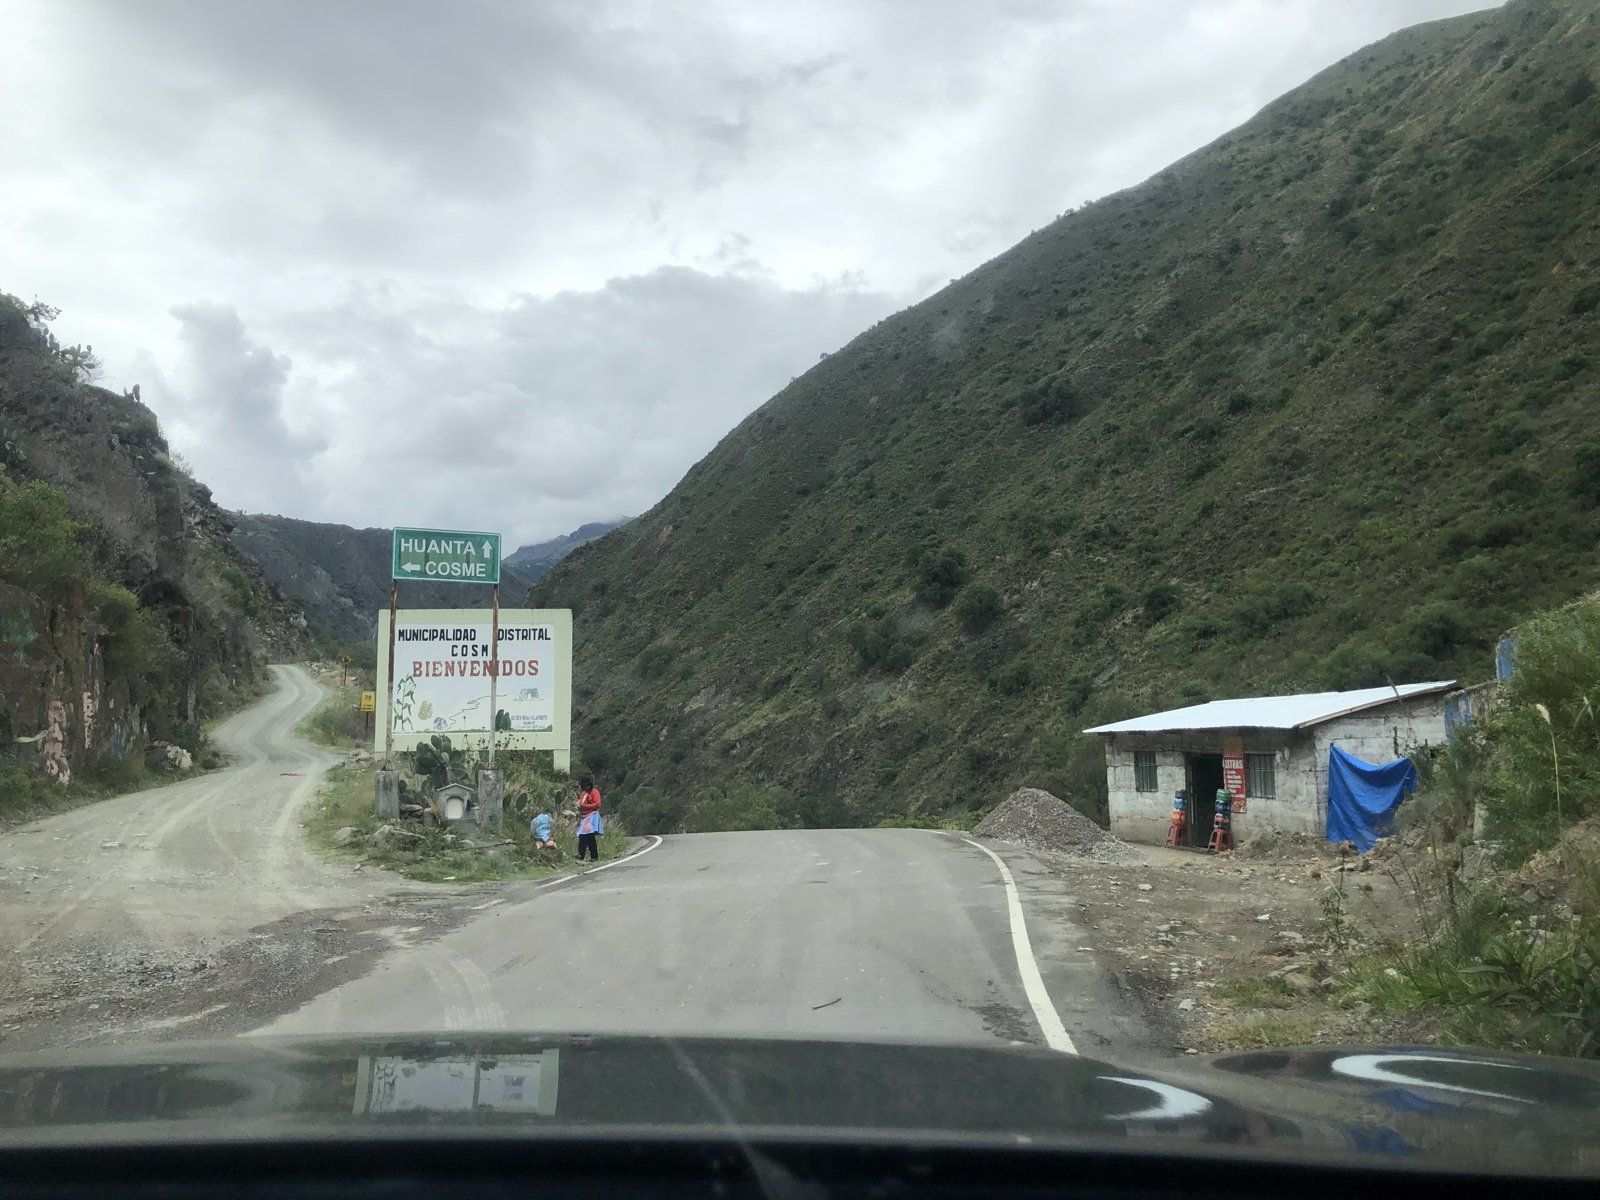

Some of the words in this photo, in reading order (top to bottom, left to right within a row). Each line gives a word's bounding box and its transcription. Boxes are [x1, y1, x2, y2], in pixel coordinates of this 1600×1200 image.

[400, 538, 476, 556] HUANTA
[425, 561, 487, 577] COSME
[398, 629, 477, 642] MUNICIPALIDAD
[498, 628, 551, 641] DISTRITAL
[451, 644, 489, 657] COSM
[412, 660, 539, 677] BIENVENIDOS
